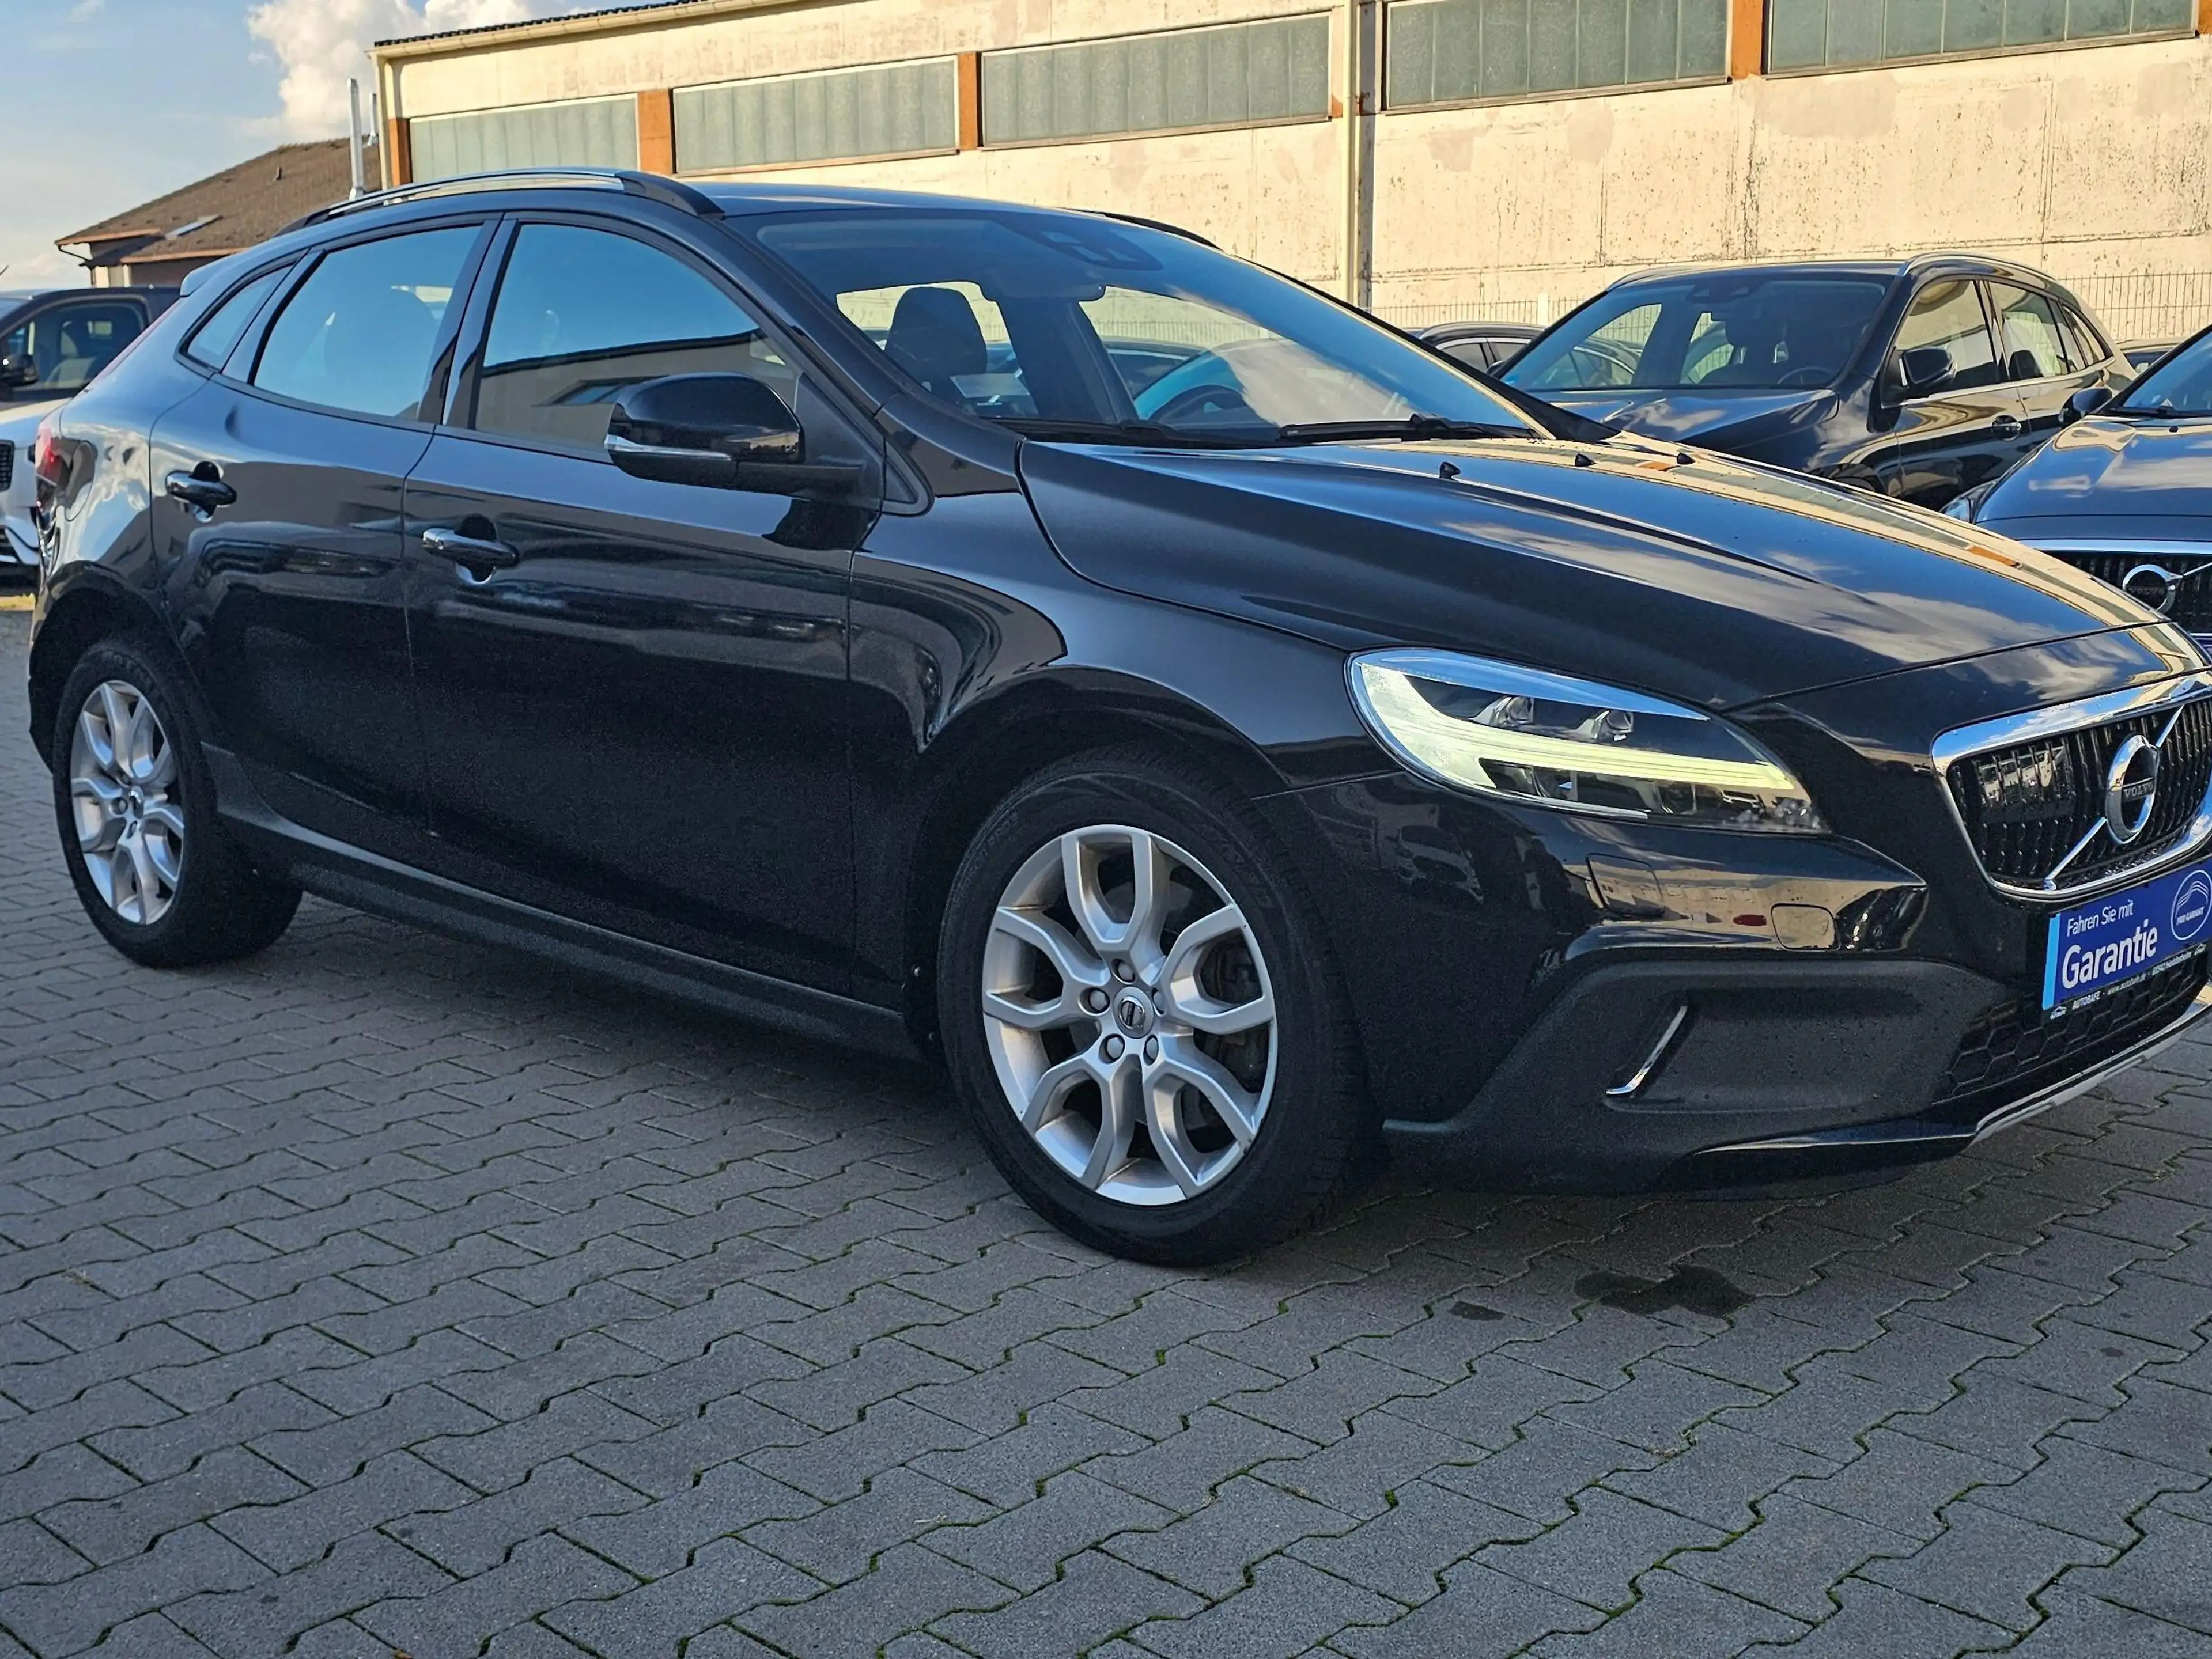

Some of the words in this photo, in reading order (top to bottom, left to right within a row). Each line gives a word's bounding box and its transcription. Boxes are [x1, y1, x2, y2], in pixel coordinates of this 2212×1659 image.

[2123, 782, 2153, 797] VOLVO
[2067, 915, 2100, 937] Fahren
[2102, 905, 2116, 925] Sie
[2118, 899, 2134, 920] mit
[2062, 918, 2158, 990] Garantie
